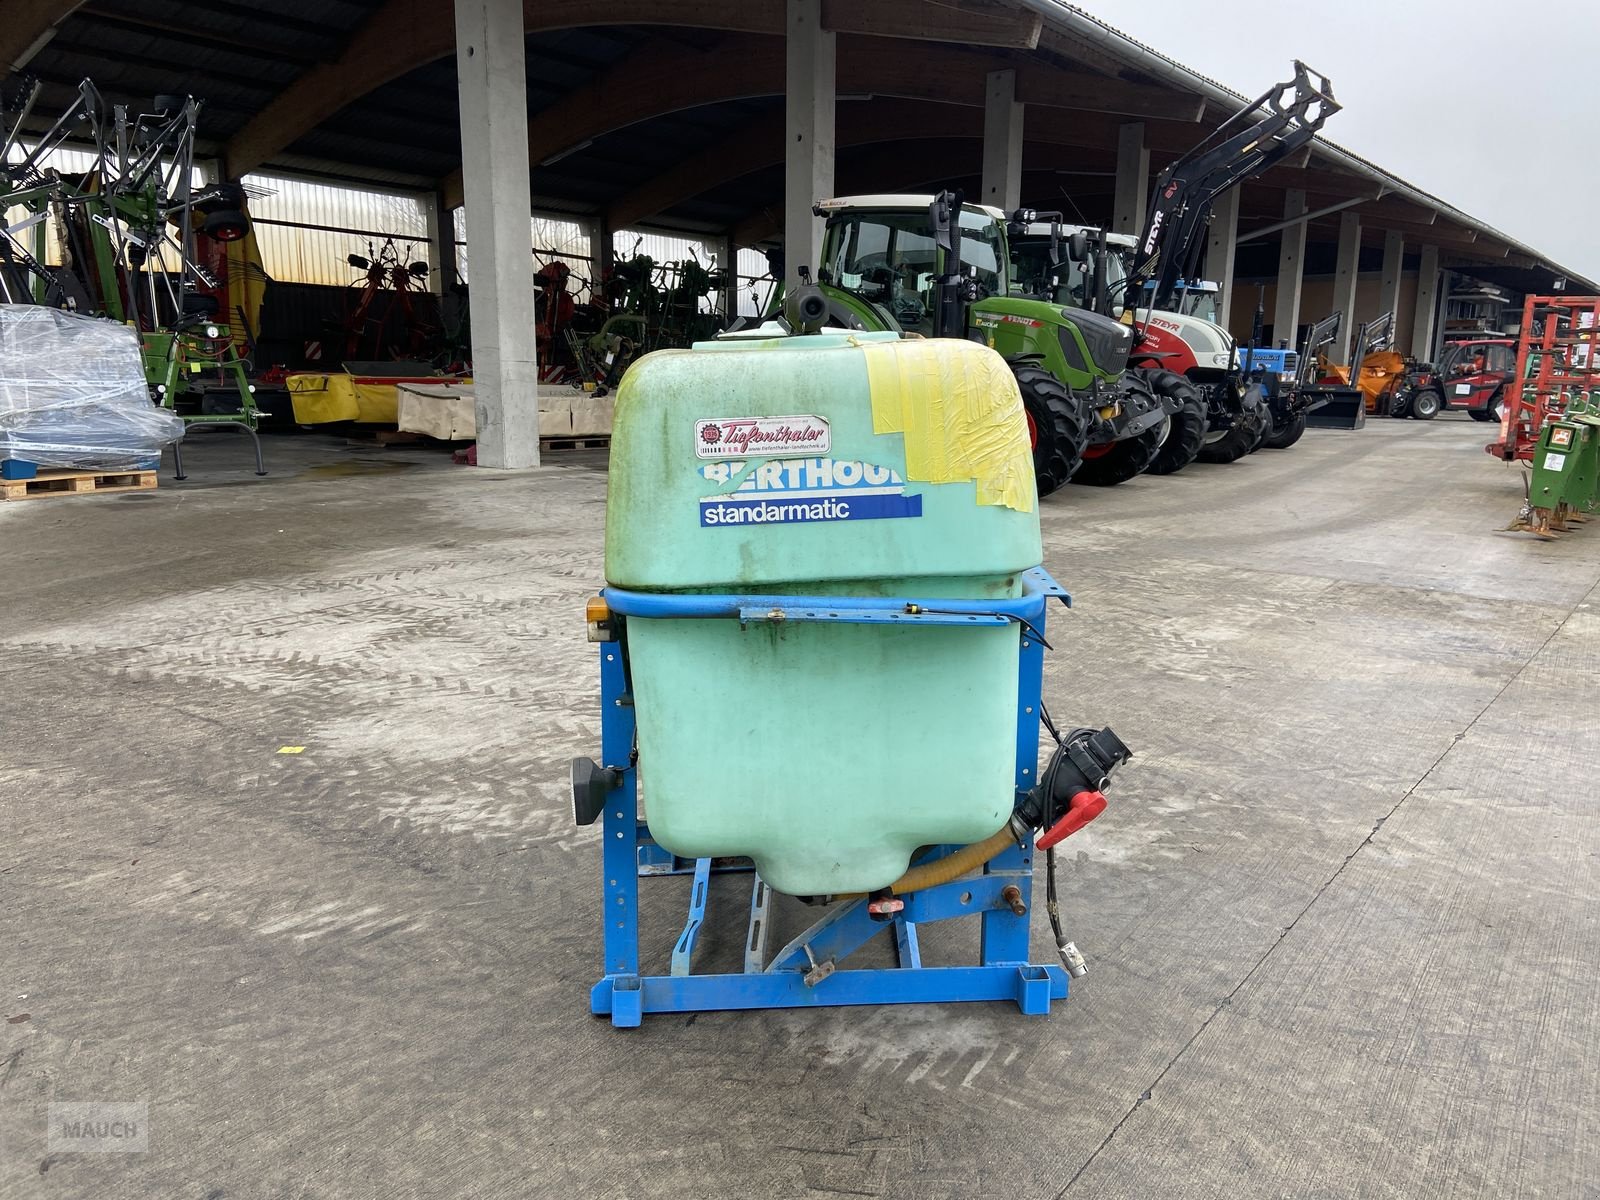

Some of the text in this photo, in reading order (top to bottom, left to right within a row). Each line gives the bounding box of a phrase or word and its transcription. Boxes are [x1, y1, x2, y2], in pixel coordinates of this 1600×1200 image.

[1144, 210, 1164, 255] STEYR
[1007, 315, 1036, 326] FENDT
[1150, 317, 1180, 332] STEYR
[721, 421, 825, 453] Tiefenthaler
[703, 458, 904, 490] BERTHOU
[704, 498, 850, 524] standarmatic
